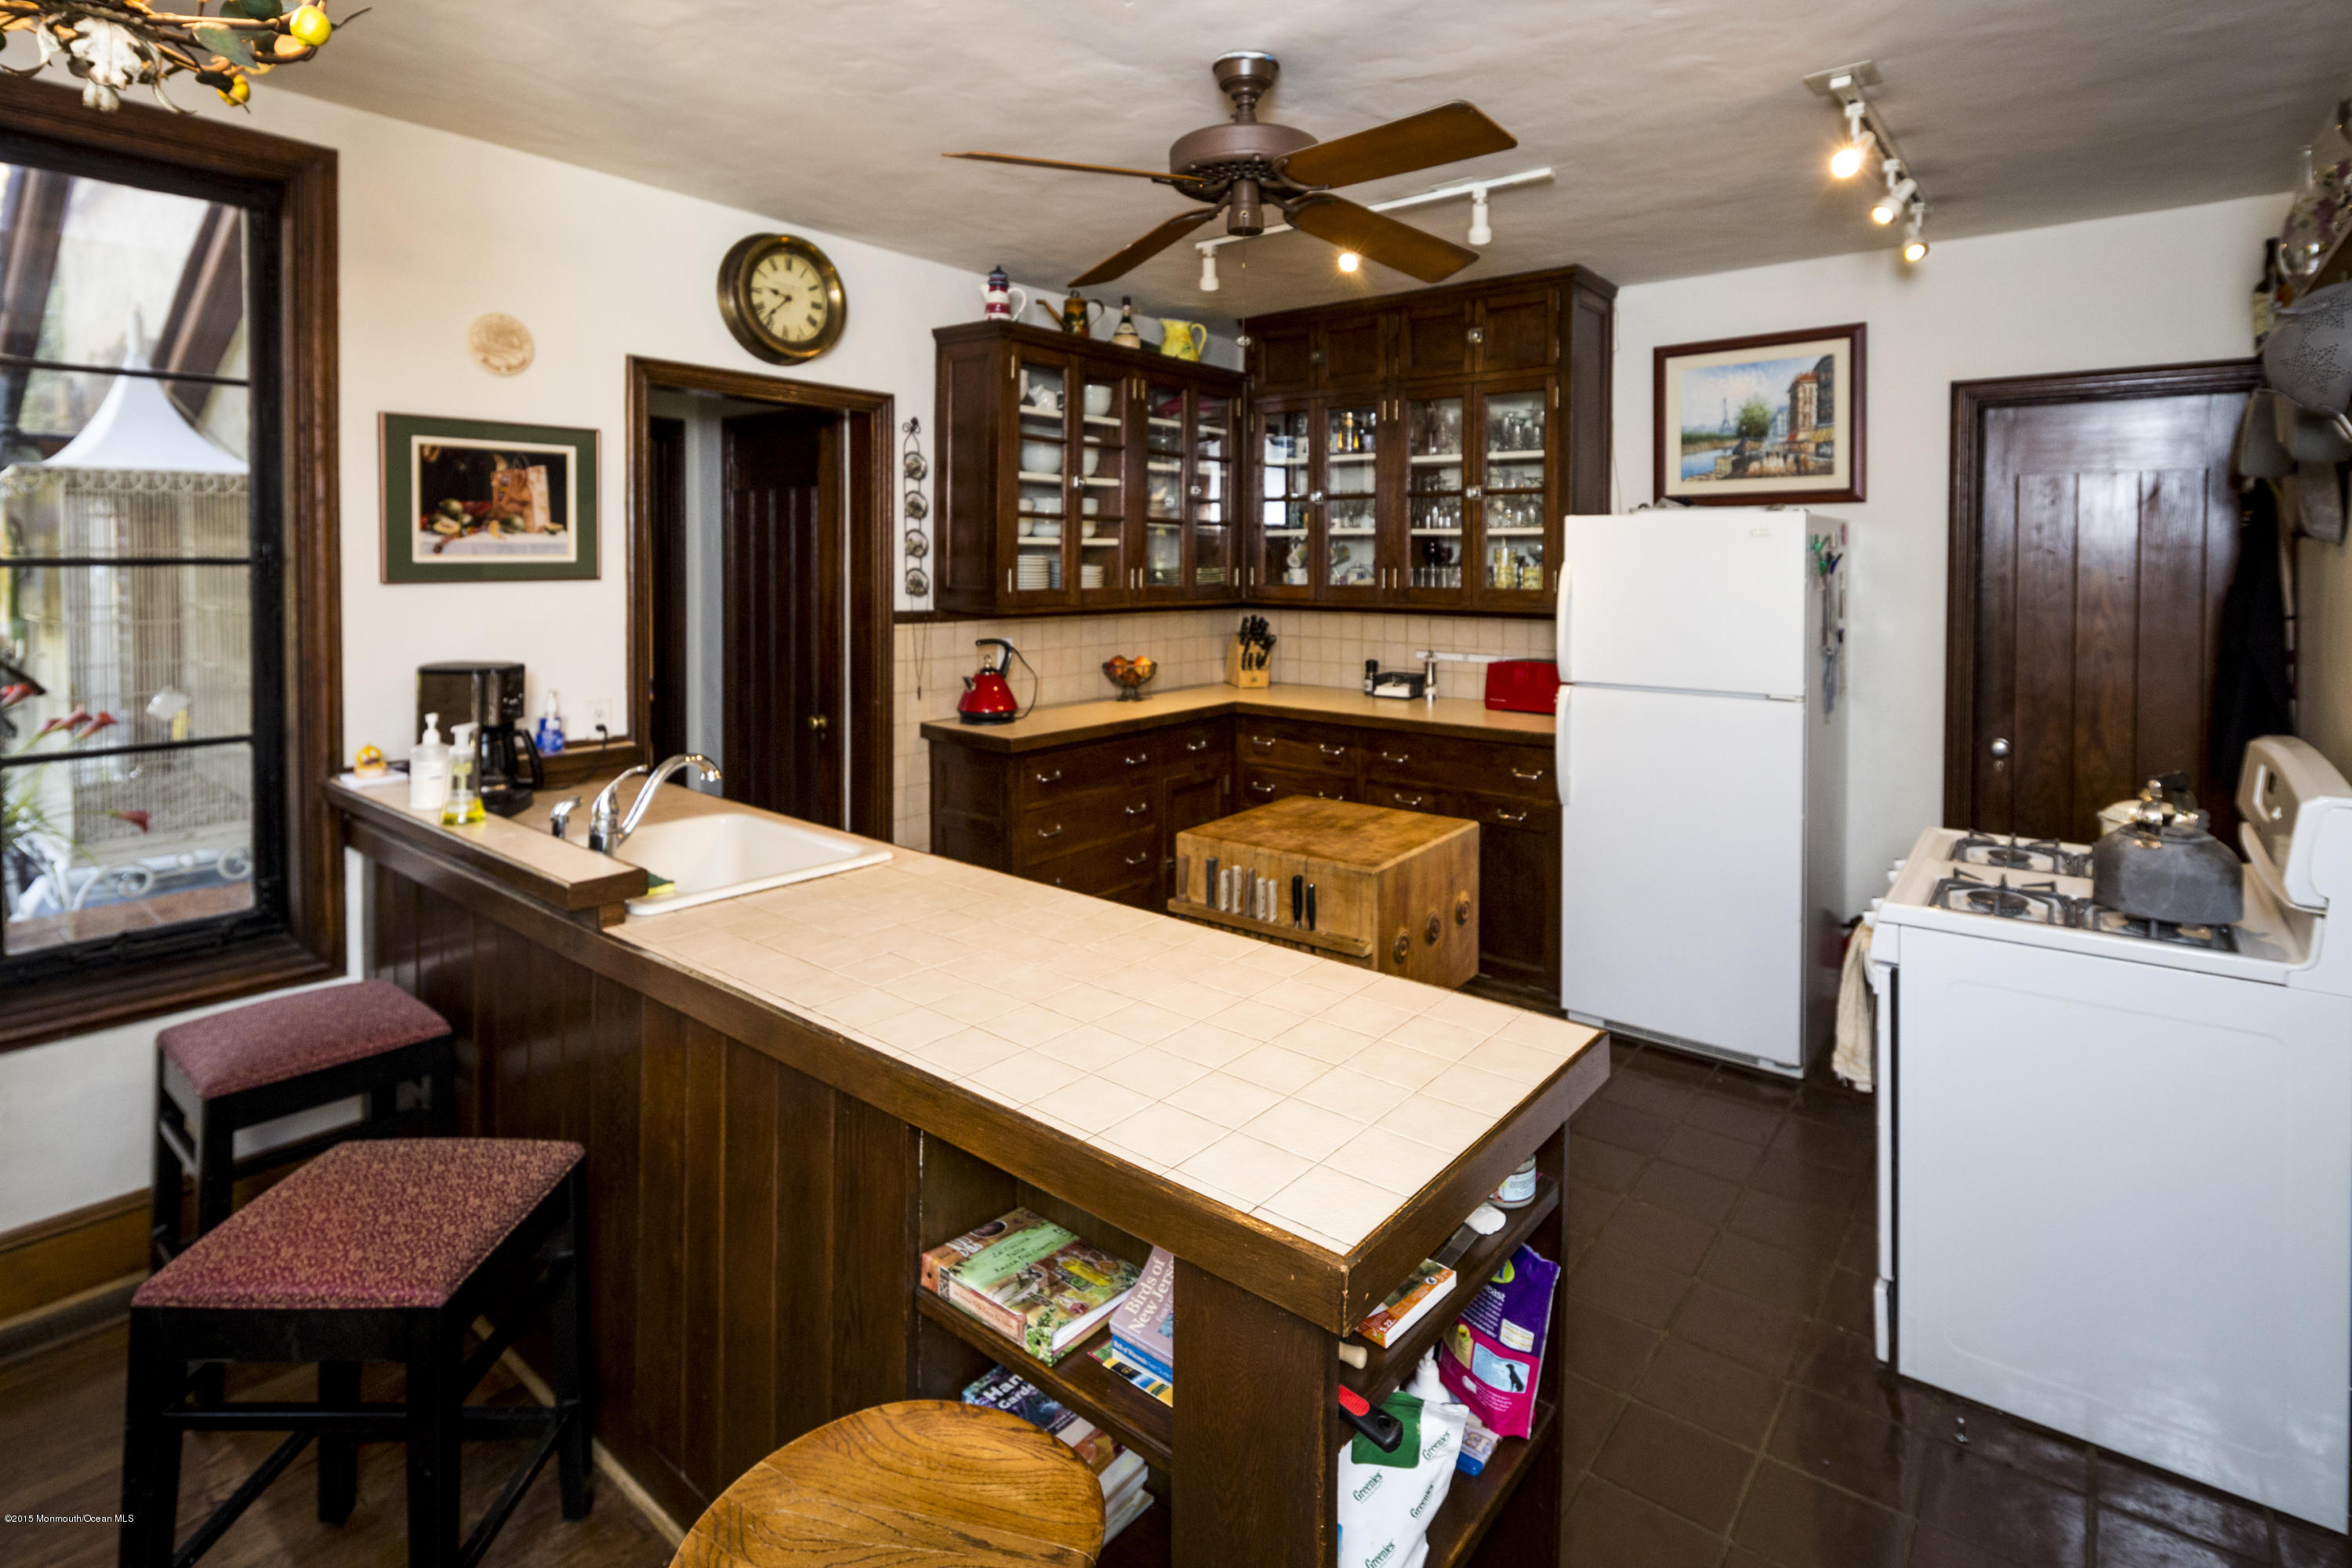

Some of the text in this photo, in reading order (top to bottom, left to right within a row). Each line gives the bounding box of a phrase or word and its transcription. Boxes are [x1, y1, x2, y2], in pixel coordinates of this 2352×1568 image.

[1124, 1255, 1166, 1315] Birds of
[1127, 1254, 1174, 1335] New Jerse
[1422, 1431, 1450, 1461] Greenies
[1352, 1472, 1384, 1502] Greenies
[1410, 1483, 1435, 1519] Greenies
[1365, 1541, 1396, 1568] Greenies
